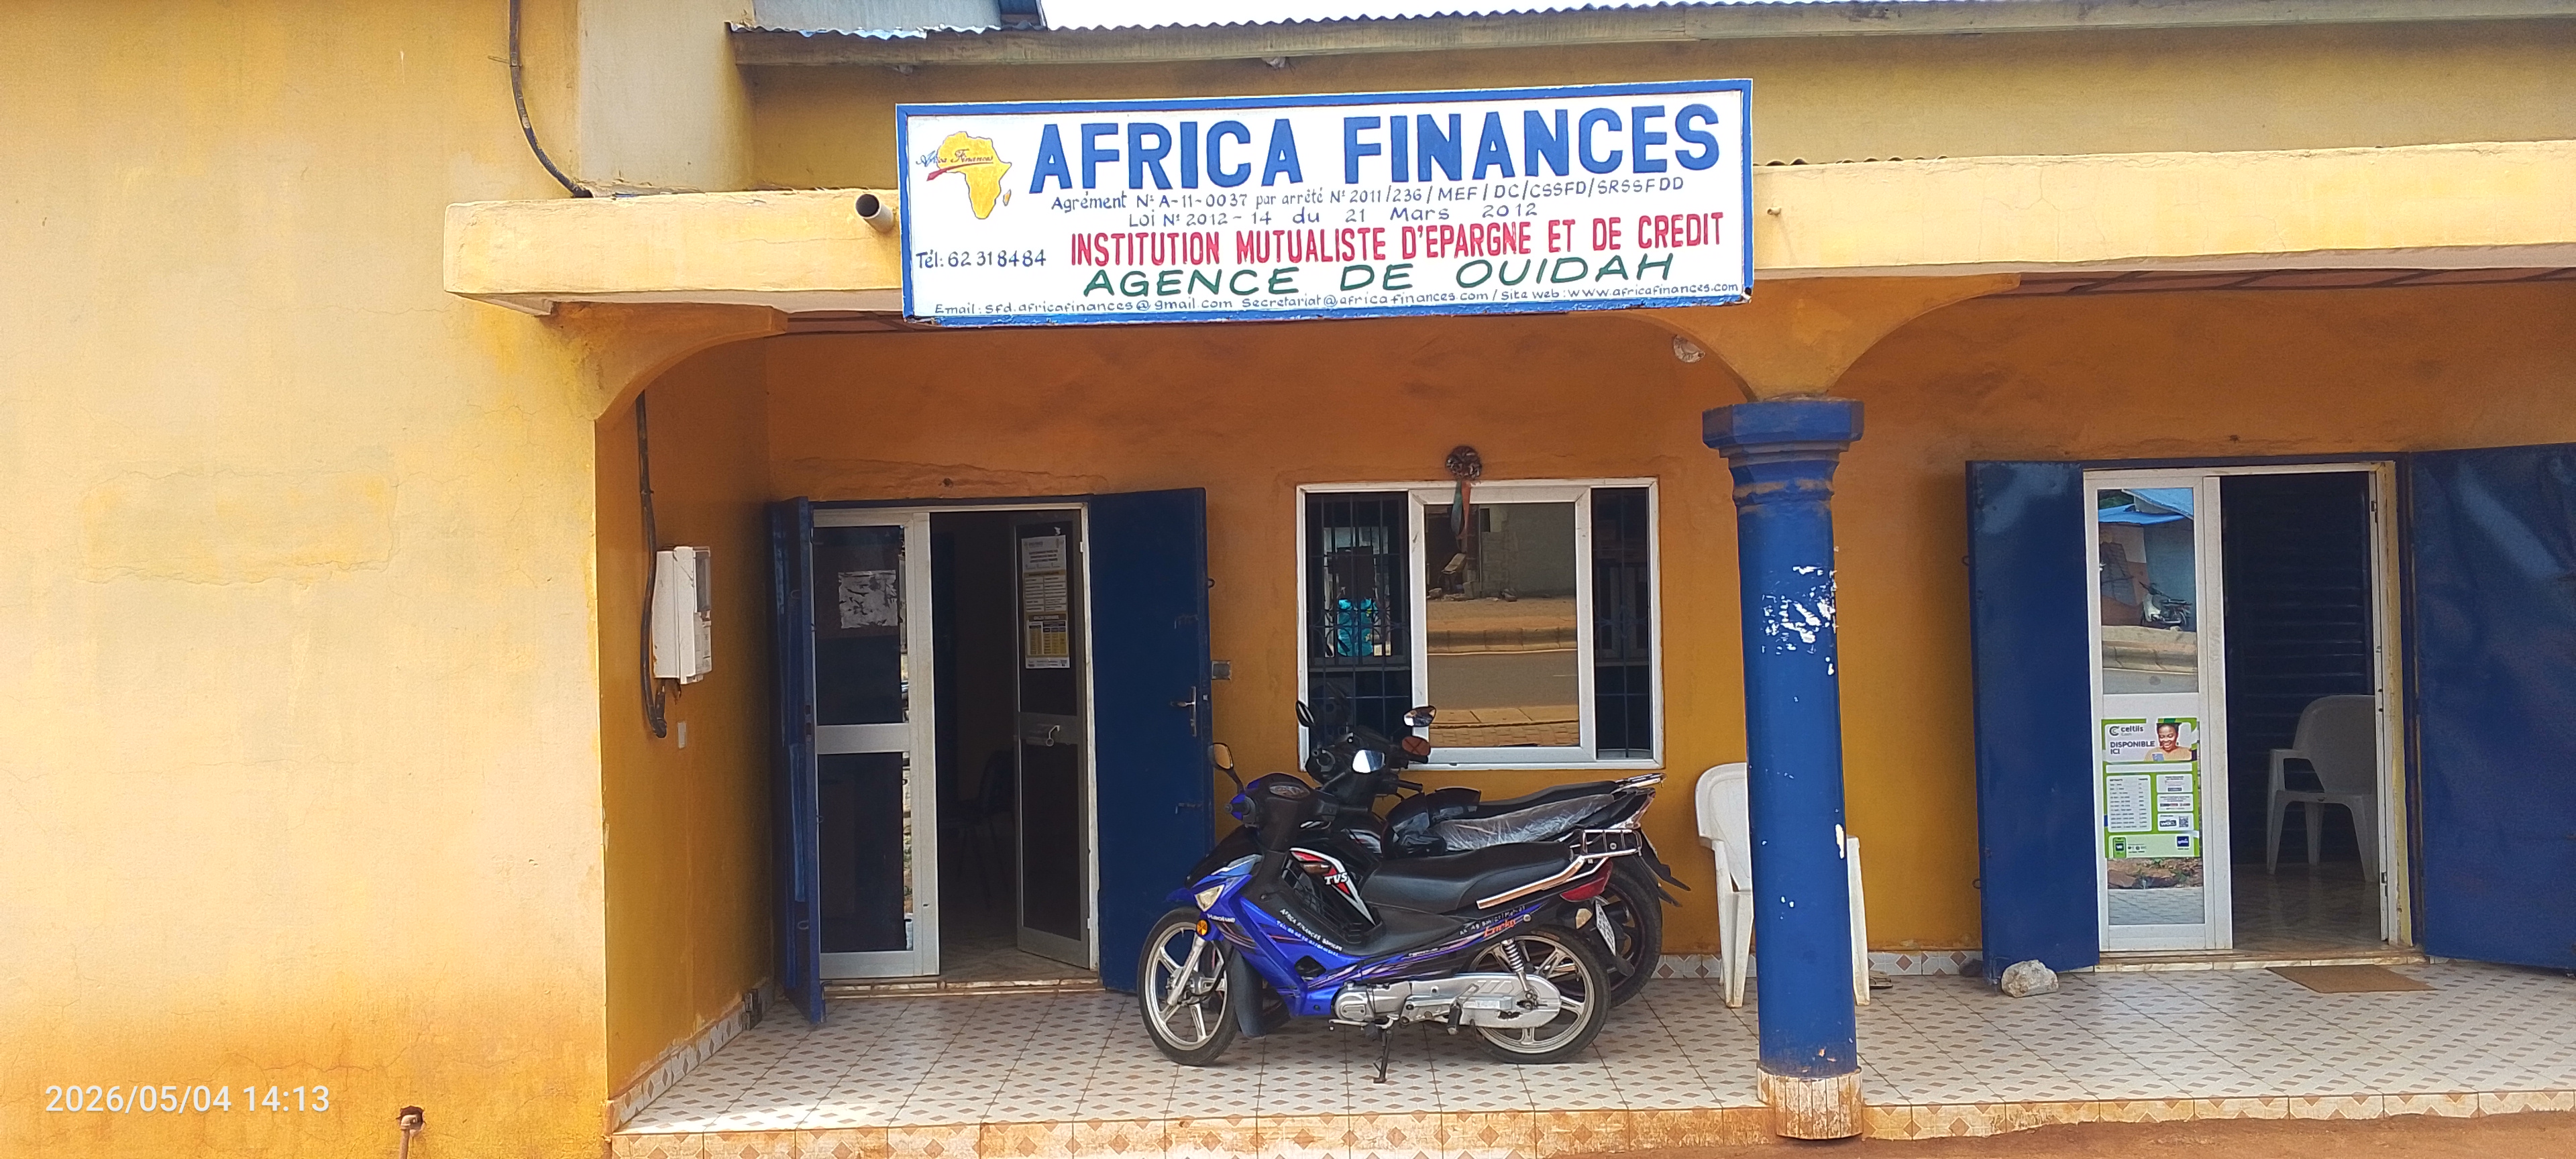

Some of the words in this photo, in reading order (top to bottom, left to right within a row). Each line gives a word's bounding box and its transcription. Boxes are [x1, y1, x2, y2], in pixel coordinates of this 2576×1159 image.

[1029, 119, 1303, 194] AFRICA
[1344, 103, 1719, 184] FINANCES
[1051, 190, 1128, 214] Agrément
[1256, 195, 1277, 210] par
[1293, 207, 1320, 224] du
[1345, 209, 1365, 223] 21
[1390, 207, 1450, 222] Mars
[1483, 203, 1538, 218] 2012
[1072, 231, 1220, 266] INSTITUTION
[1236, 227, 1386, 264] MUTUALISTE
[1402, 222, 1532, 260] D'EPARGNE
[1548, 219, 1576, 254] ET
[1593, 217, 1622, 252] DE
[1638, 212, 1725, 250] CREDIT
[915, 249, 945, 268] Tél:
[1083, 267, 1299, 298] AGENCE
[1340, 264, 1413, 292] DE
[1456, 253, 1674, 288] OUIDAH
[1324, 872, 1348, 885] TVS
